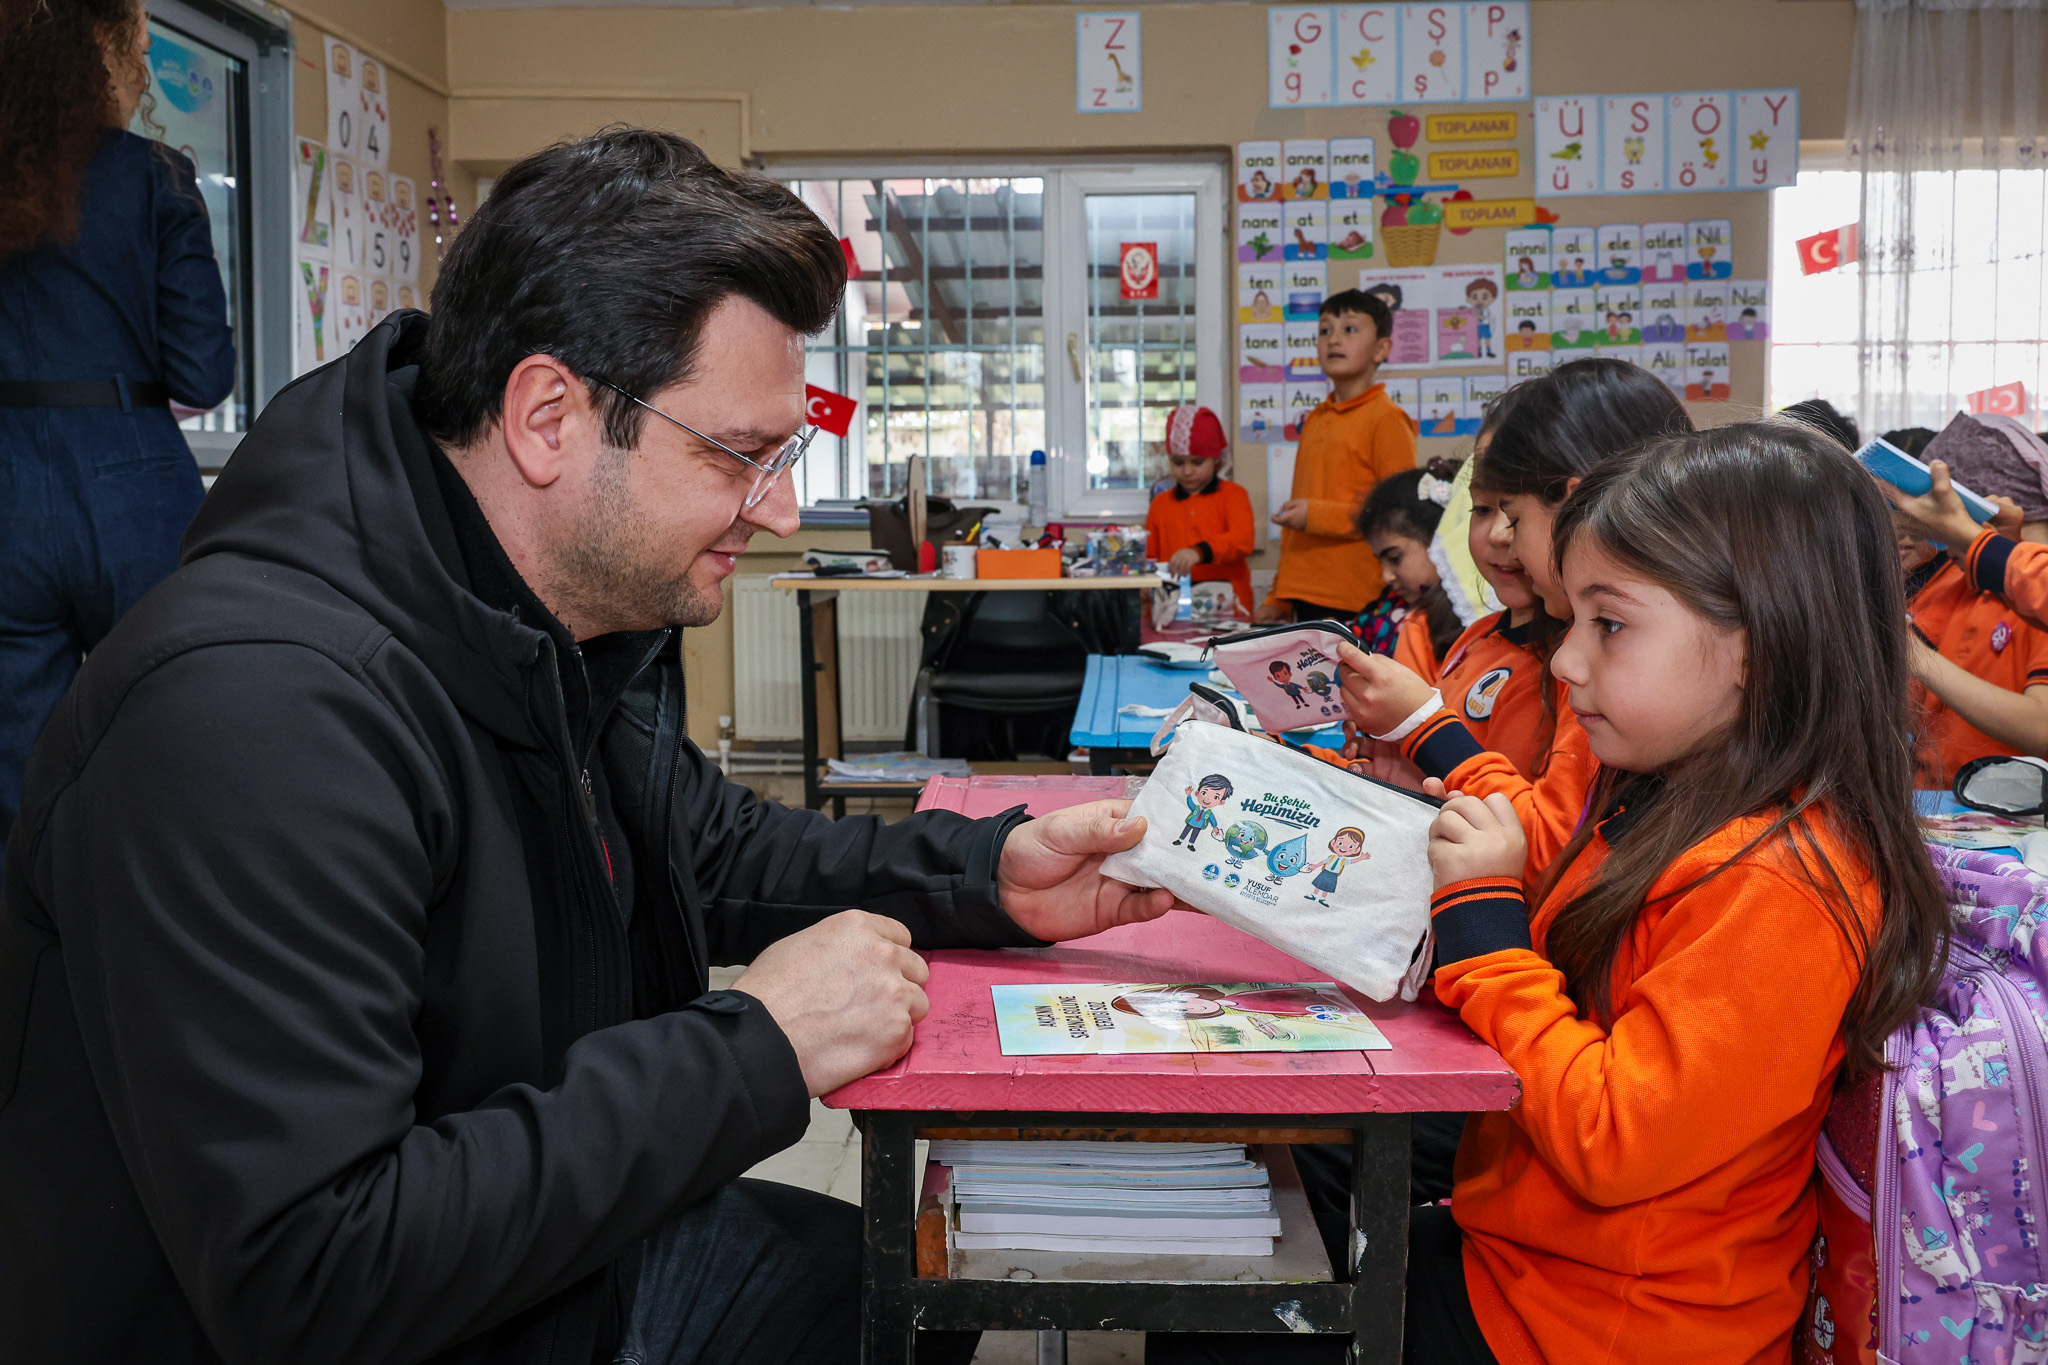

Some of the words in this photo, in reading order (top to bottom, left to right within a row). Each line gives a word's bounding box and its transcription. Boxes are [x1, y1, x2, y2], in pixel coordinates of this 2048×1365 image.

[1294, 12, 1322, 44] G
[1359, 10, 1384, 42] C
[1427, 8, 1447, 46] Ş
[1487, 5, 1505, 38] P
[1104, 19, 1126, 49] Z
[1285, 72, 1301, 102] g
[1559, 99, 1583, 138] Ü
[1630, 101, 1650, 133] S
[1691, 96, 1721, 135] Ö
[1764, 95, 1787, 126] Y
[339, 110, 351, 148] 0
[1436, 120, 1509, 134] TOPLANAN
[367, 125, 379, 160] 4
[1245, 155, 1275, 167] ana
[1286, 153, 1324, 165] anne
[1333, 153, 1370, 166] nene
[1438, 157, 1512, 171] TOPLANAN
[1241, 217, 1279, 229] nane
[1297, 213, 1314, 227] at
[1343, 211, 1359, 225] et
[1460, 207, 1516, 221] TOPLAM
[1565, 234, 1580, 253] al
[1607, 232, 1631, 250] ele
[1645, 230, 1682, 249] atlet
[1695, 228, 1722, 246] Nil
[373, 232, 386, 268] 5
[400, 240, 411, 273] 9
[1509, 242, 1547, 256] ninni
[1250, 275, 1273, 290] ten
[1293, 273, 1318, 287] tan
[1565, 296, 1580, 314] el
[1596, 294, 1609, 312] el
[1618, 293, 1641, 311] ele
[1650, 291, 1676, 309] nal
[1693, 290, 1723, 308] ilan
[1731, 288, 1767, 306] Nail
[1512, 302, 1542, 317] inat
[1245, 334, 1278, 349] tane
[1651, 350, 1676, 370] Ali
[1687, 348, 1729, 368] Talat
[1250, 394, 1274, 408] net
[1435, 389, 1449, 402] in
[1263, 792, 1278, 803] Bu
[1279, 795, 1311, 810] Şehir
[1240, 798, 1321, 828] Hepimizin
[1243, 885, 1279, 903] ALEMDAR
[1247, 879, 1272, 892] YUSUF
